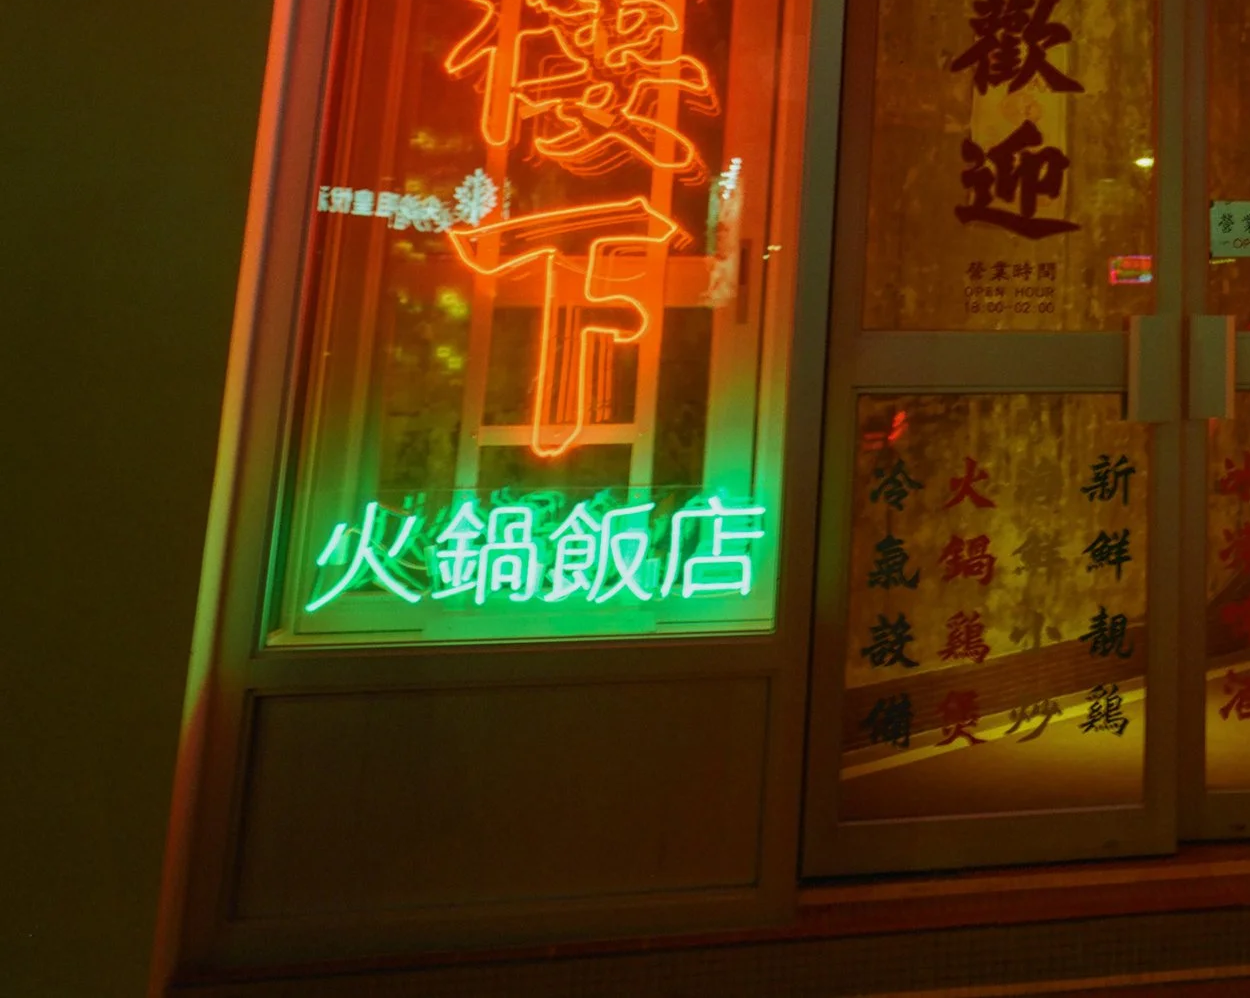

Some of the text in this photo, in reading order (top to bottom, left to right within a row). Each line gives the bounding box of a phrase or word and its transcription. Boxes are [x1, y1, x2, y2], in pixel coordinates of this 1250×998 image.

[965, 259, 1058, 282] 營業時間
[964, 286, 1055, 299] OPEN HOUR
[305, 498, 767, 613] 火鍋飯店
